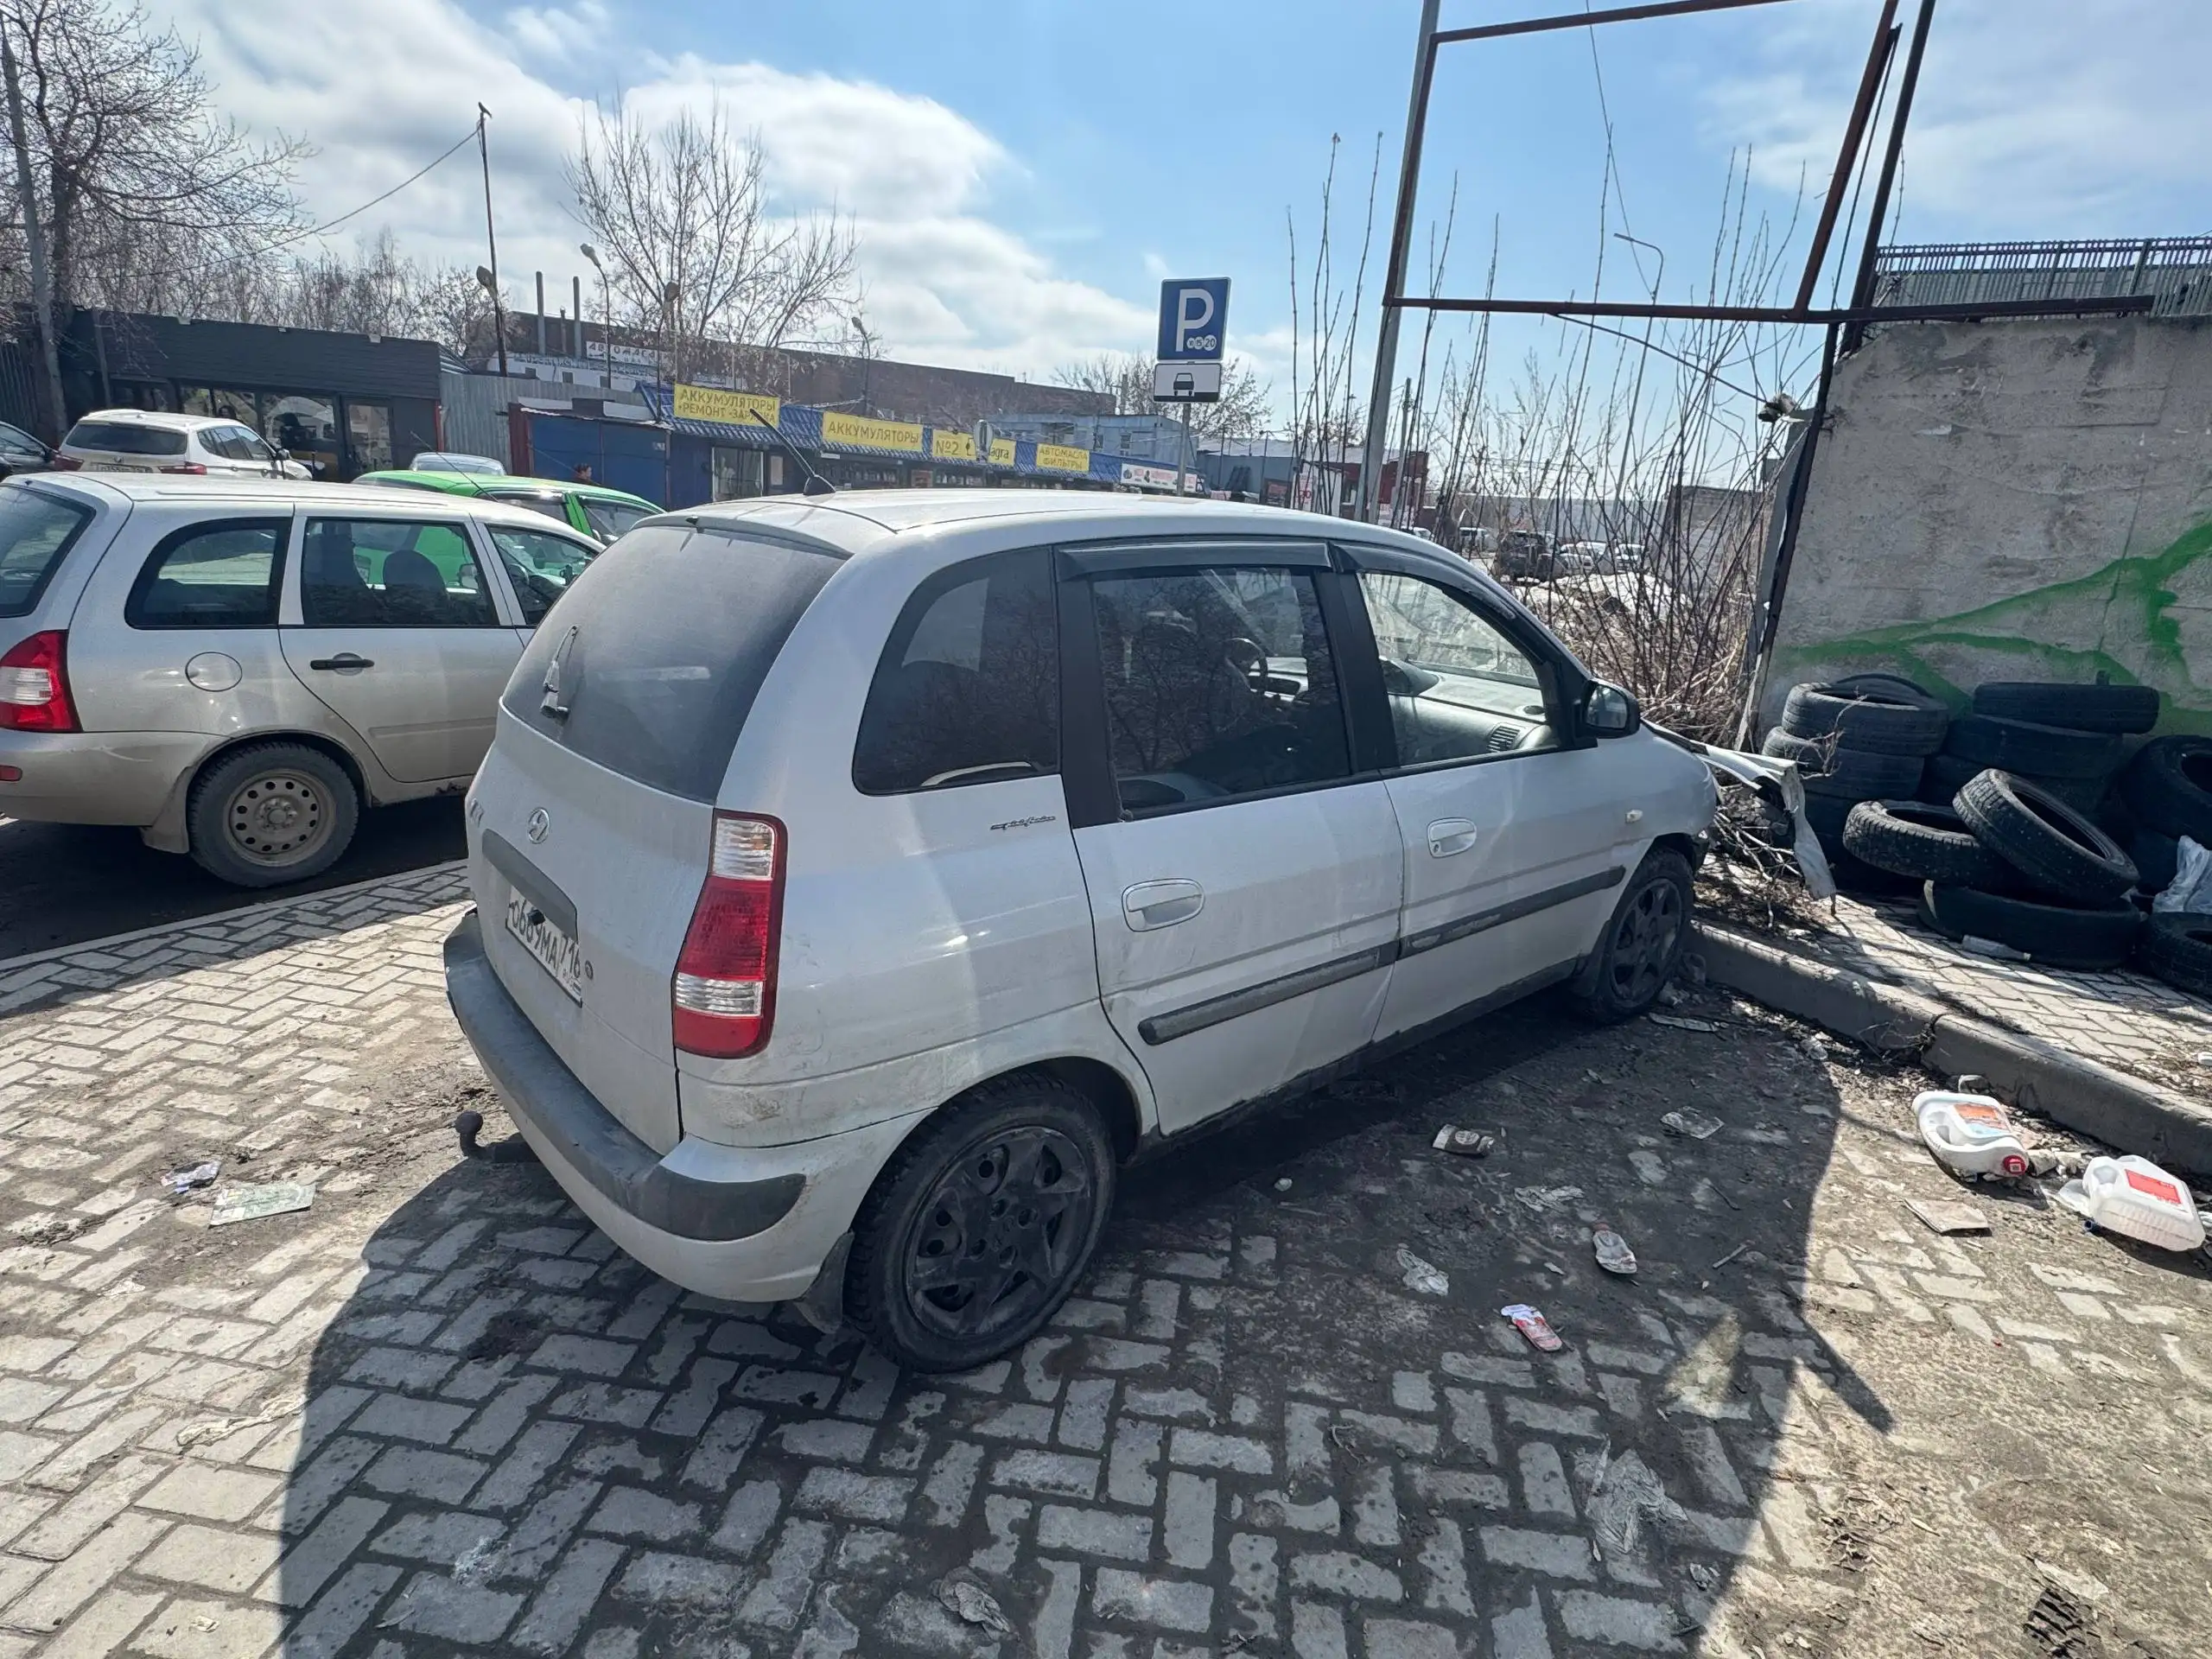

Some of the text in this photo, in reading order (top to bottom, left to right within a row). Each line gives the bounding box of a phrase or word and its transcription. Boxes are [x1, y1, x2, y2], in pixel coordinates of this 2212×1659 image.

[1176, 289, 1214, 352] P
[679, 388, 776, 410] АККУМУЛЯТОРЫ
[683, 402, 776, 423] РЕМОНТ ЗАРКА
[828, 421, 918, 443] АККУМУЛЯТОРЫ
[1039, 445, 1087, 460] АВТОМАСЛА
